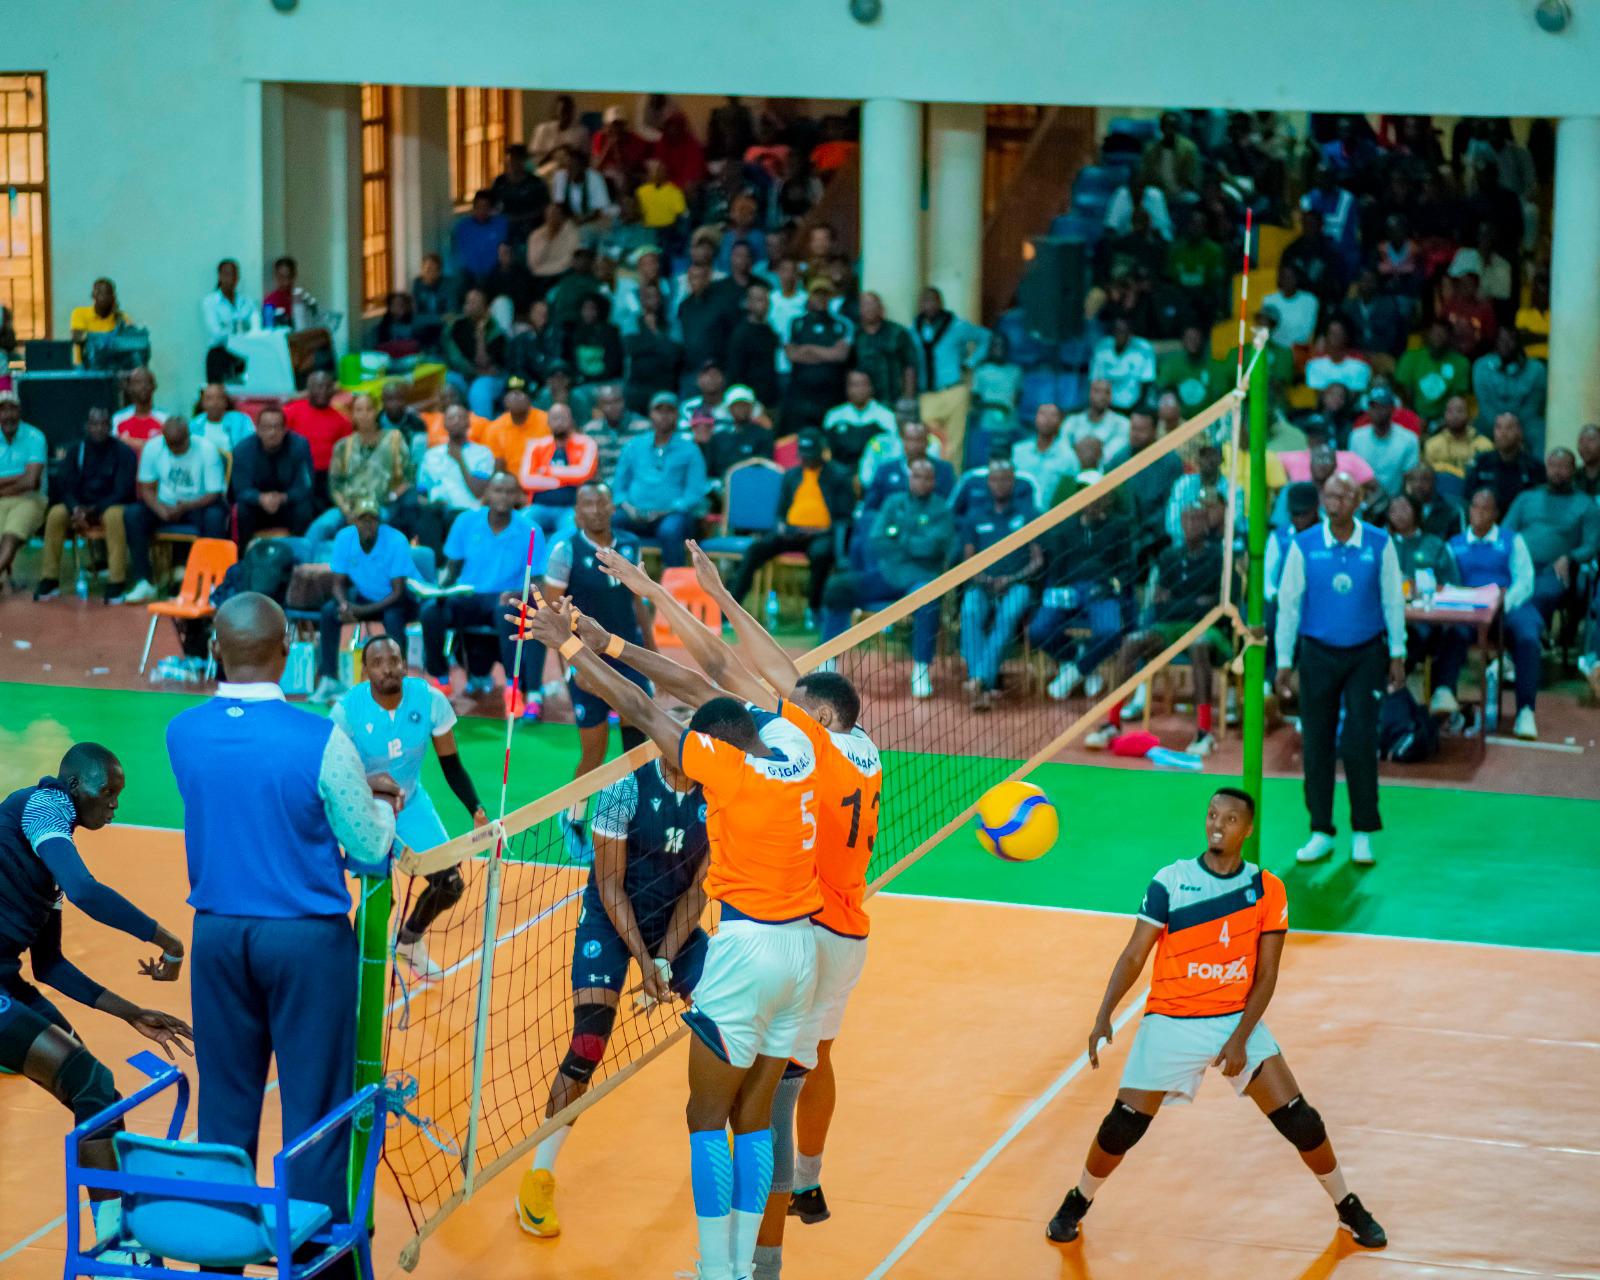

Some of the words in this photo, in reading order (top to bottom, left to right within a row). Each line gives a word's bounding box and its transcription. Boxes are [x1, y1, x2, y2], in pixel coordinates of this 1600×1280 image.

[388, 738, 403, 760] 12
[801, 790, 817, 850] 5
[1219, 920, 1230, 949] 4
